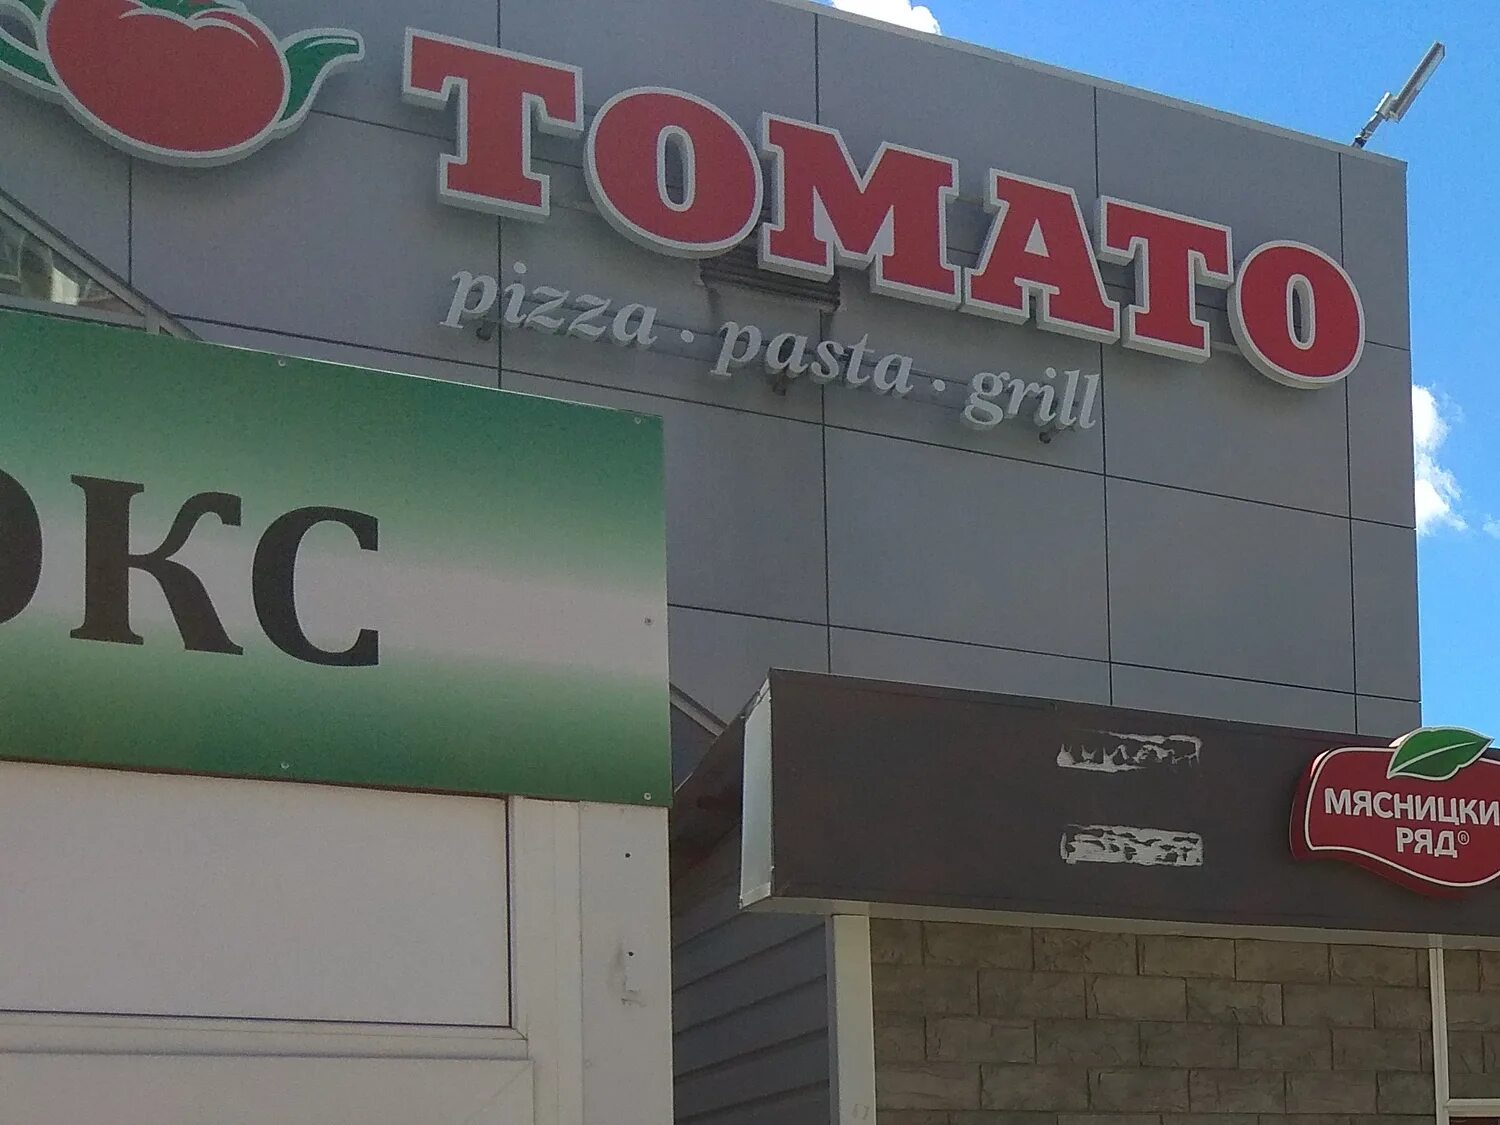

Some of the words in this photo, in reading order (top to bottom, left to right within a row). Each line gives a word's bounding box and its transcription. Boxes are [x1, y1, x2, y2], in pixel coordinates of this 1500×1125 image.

[402, 27, 1365, 390] TOMATO
[441, 262, 658, 347] pizza
[711, 319, 914, 395] pasta
[961, 367, 1100, 430] grill
